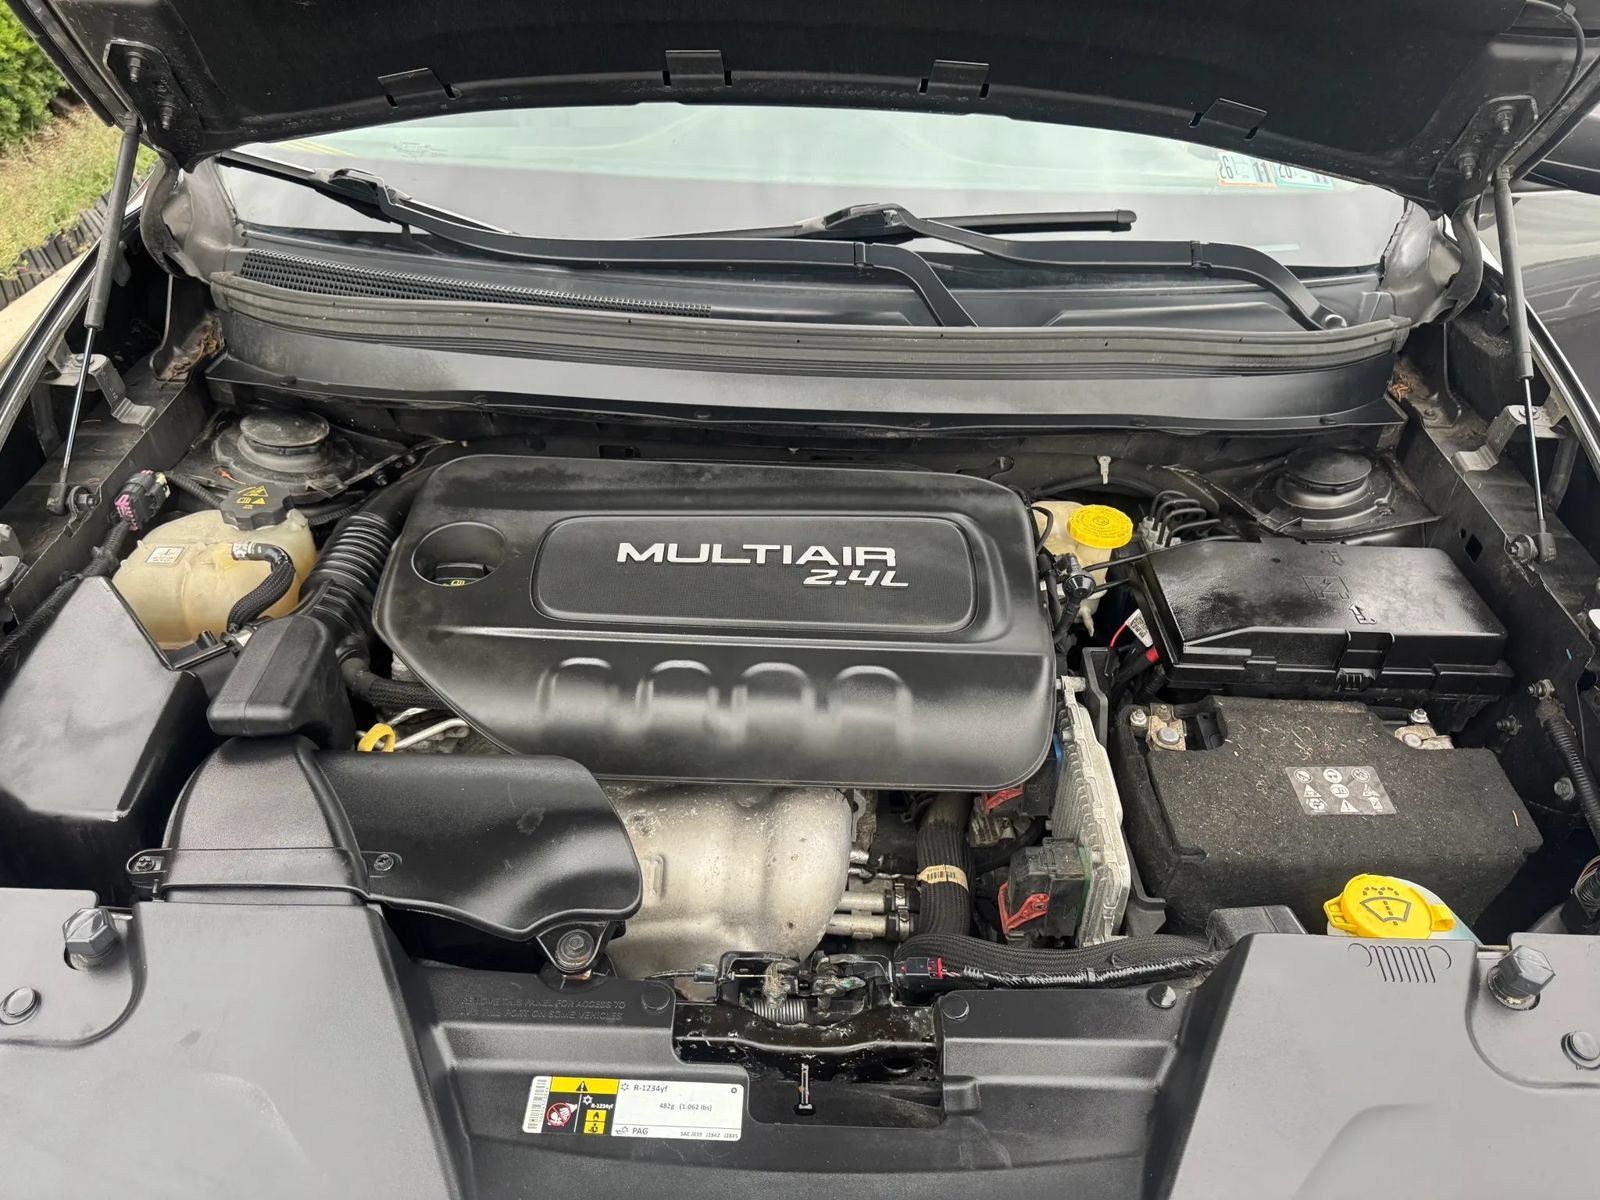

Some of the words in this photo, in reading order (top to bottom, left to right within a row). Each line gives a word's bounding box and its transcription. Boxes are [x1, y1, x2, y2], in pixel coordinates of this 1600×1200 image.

[616, 542, 897, 567] MULTIAIR
[802, 569, 909, 587] 2.4L
[555, 1000, 575, 1008] FOR
[576, 1000, 612, 1009] ACCESS
[548, 1010, 576, 1019] SOME
[578, 1011, 624, 1020] VEHICLES
[633, 1084, 669, 1094] R-1234yf
[632, 1127, 649, 1136] PAG
